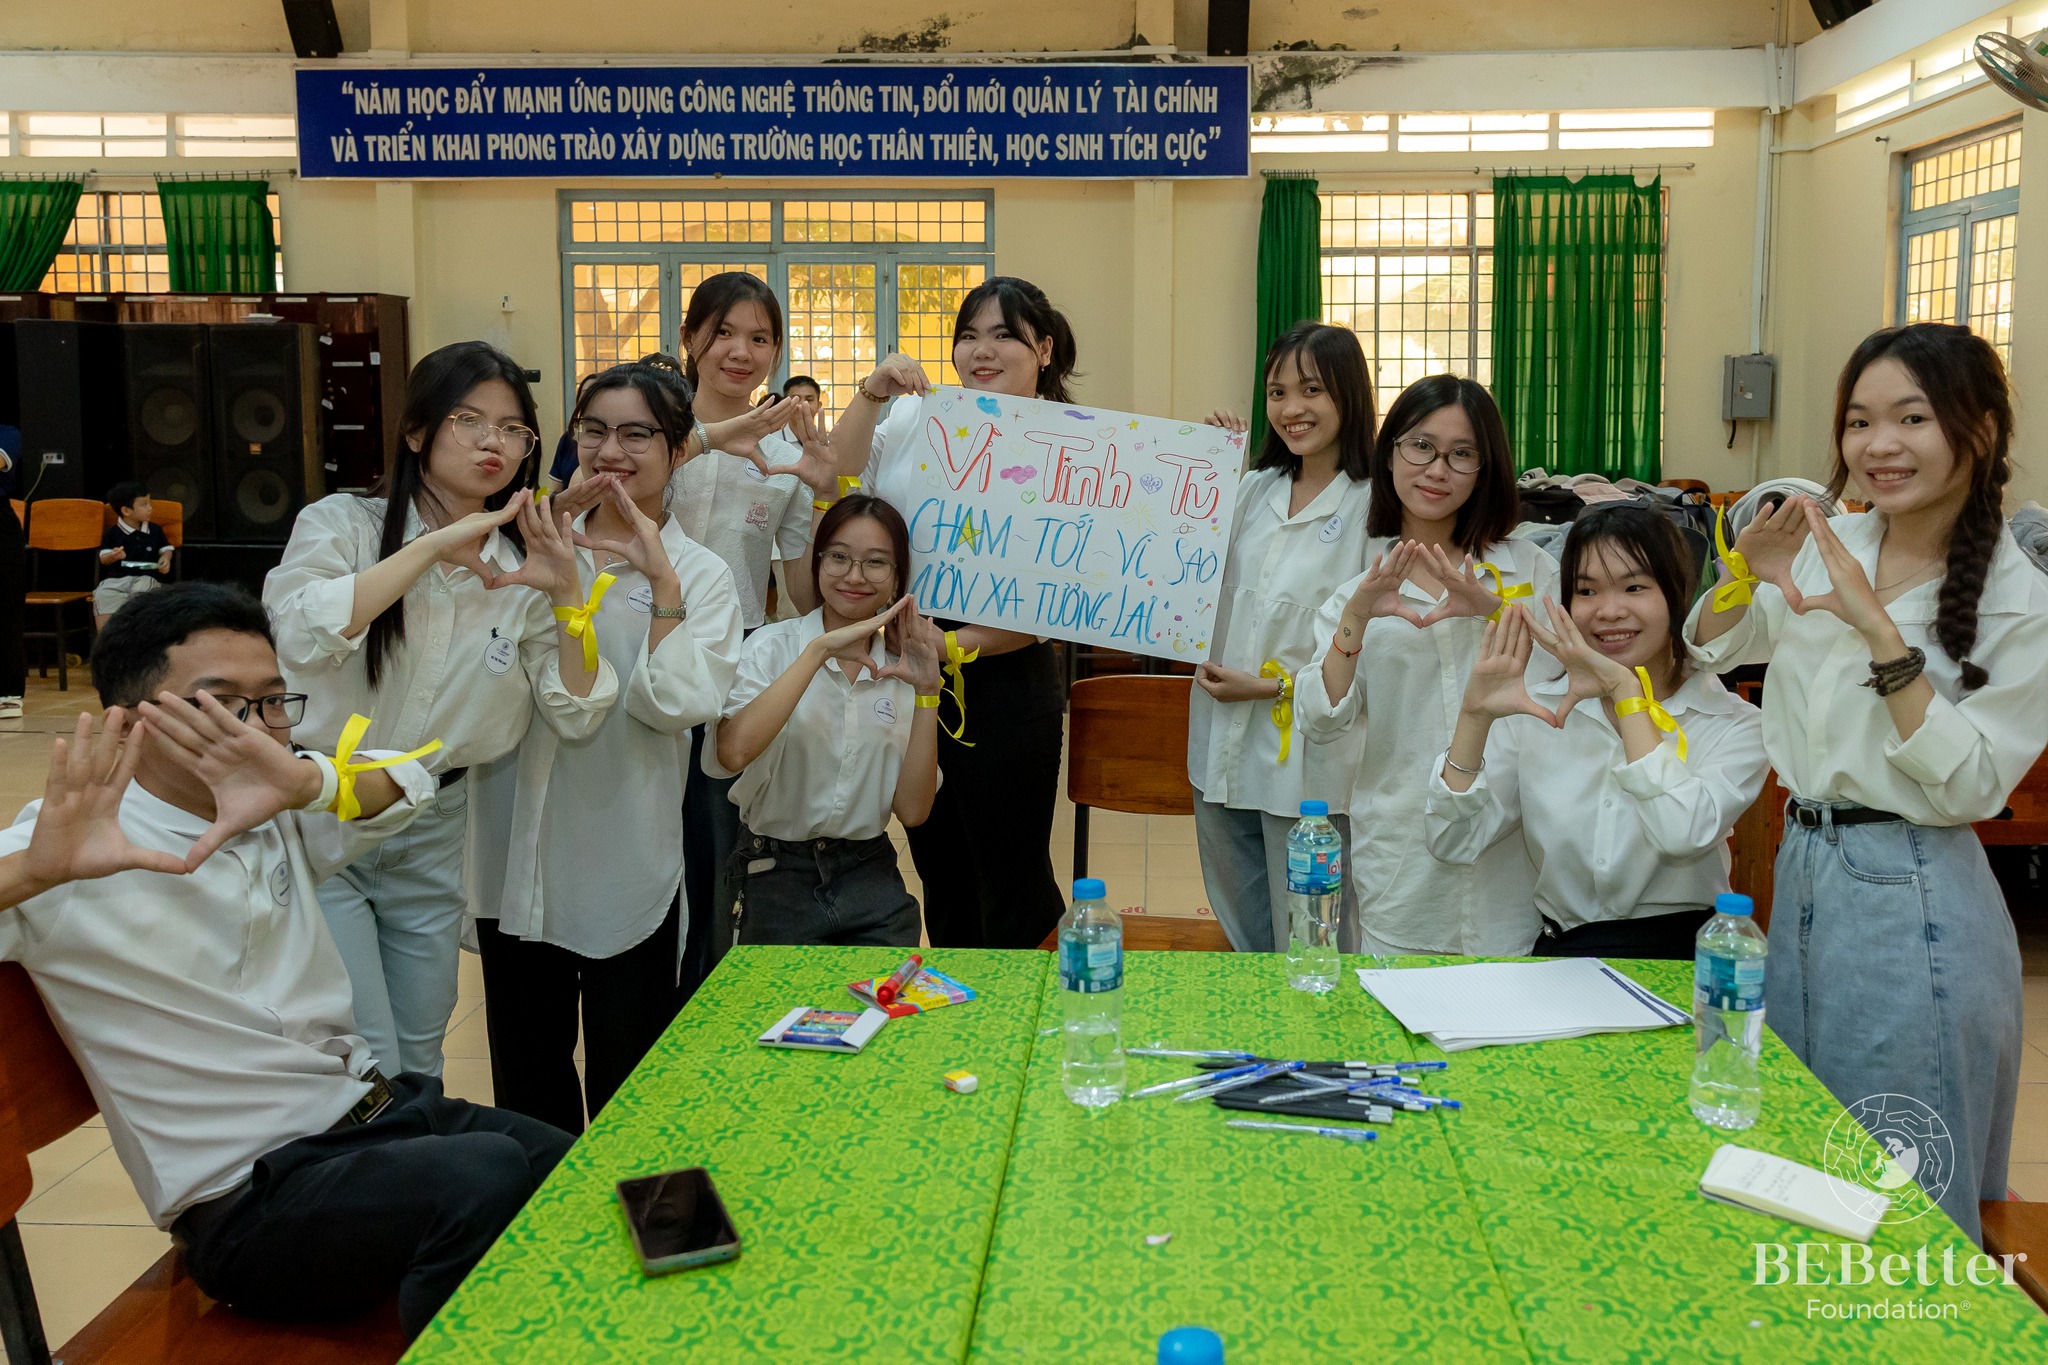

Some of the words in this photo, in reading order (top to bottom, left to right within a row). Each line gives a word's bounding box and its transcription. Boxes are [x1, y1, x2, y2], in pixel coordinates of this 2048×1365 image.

[407, 86, 449, 121] HỌC
[455, 72, 496, 114] ĐẨY
[503, 86, 562, 120] MẠNH
[570, 77, 611, 113] ỨNG
[617, 86, 673, 120] DỤNG
[680, 79, 735, 113] CÔNG
[742, 80, 795, 119] NGHỆ
[803, 79, 873, 113] THÔNG
[966, 78, 1006, 113] MỚI
[1012, 75, 1069, 118] QUẢN
[1076, 80, 1103, 113] LÝ
[1113, 79, 1148, 113] TÀI
[1154, 79, 1218, 113] CHÍNH
[331, 127, 358, 162] VÀ
[364, 121, 425, 162] TRIỂN
[433, 133, 480, 161] KHAI
[487, 133, 556, 161] PHONG
[561, 127, 616, 161] TRÀO
[622, 126, 661, 160] XÂY
[669, 128, 725, 167] DỰNG
[730, 125, 814, 161] TRƯỜNG
[820, 133, 862, 167] HỌC
[868, 127, 924, 161] THÂN
[930, 126, 999, 167] THIỆN,
[1006, 133, 1048, 167] HỌC
[1055, 133, 1103, 161] SINH
[1110, 126, 1158, 161] TÍCH
[1162, 537, 1218, 586] SAO
[977, 572, 1025, 619] XA
